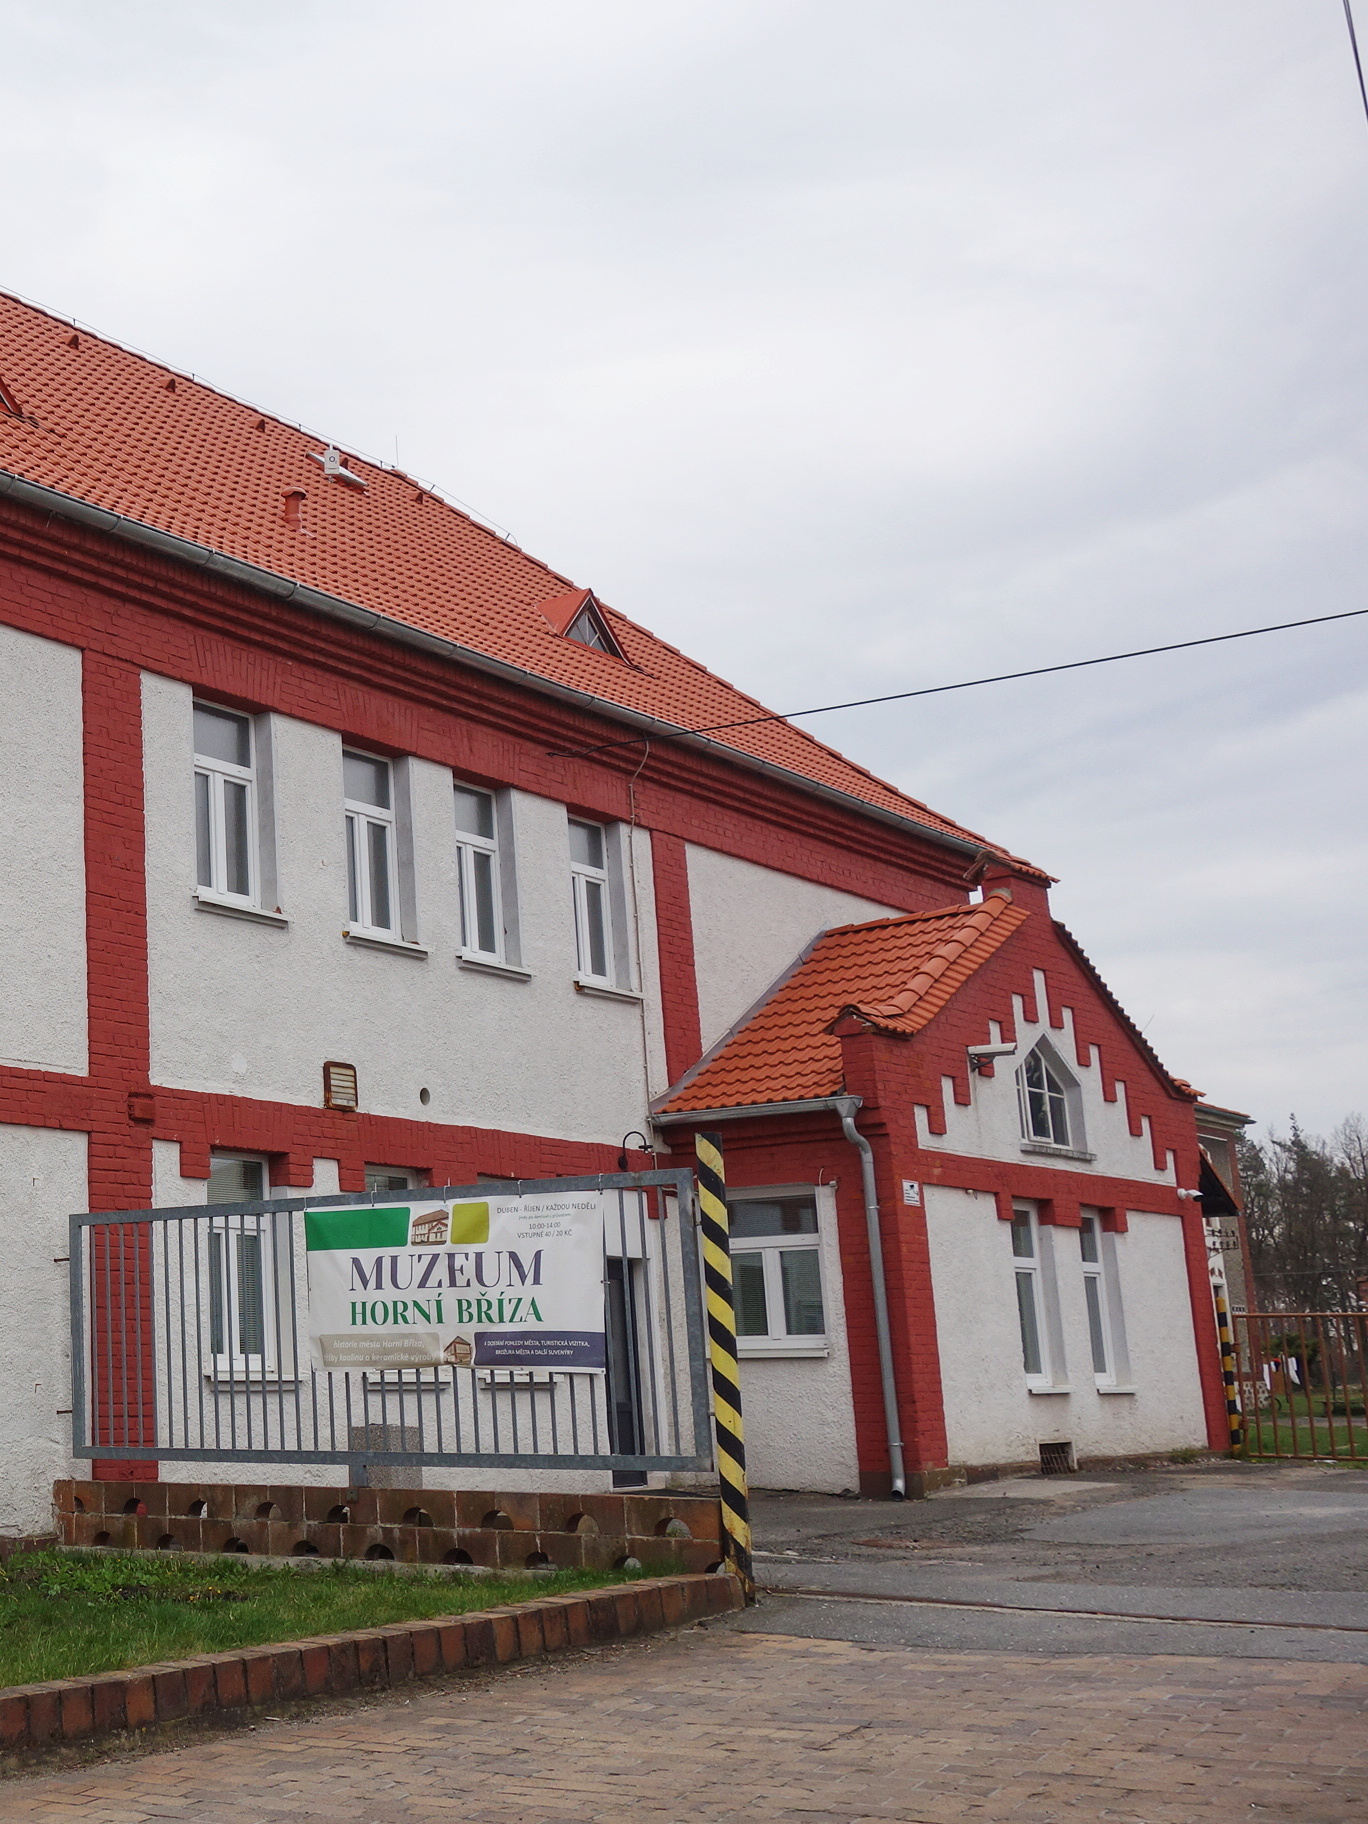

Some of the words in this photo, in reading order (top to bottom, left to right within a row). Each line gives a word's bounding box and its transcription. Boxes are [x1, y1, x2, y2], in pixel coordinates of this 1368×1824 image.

[545, 1203, 571, 1211] KAŽDOU
[571, 1202, 597, 1210] NEDĚLI
[529, 1221, 561, 1230] 10:00-14:00
[517, 1231, 543, 1239] VSTUPNÉ
[348, 1249, 544, 1292] MUZEUM
[350, 1292, 445, 1326] HORNÍ
[456, 1291, 544, 1324] BŘÍZA
[333, 1340, 358, 1349] historie
[382, 1340, 403, 1348] Horní
